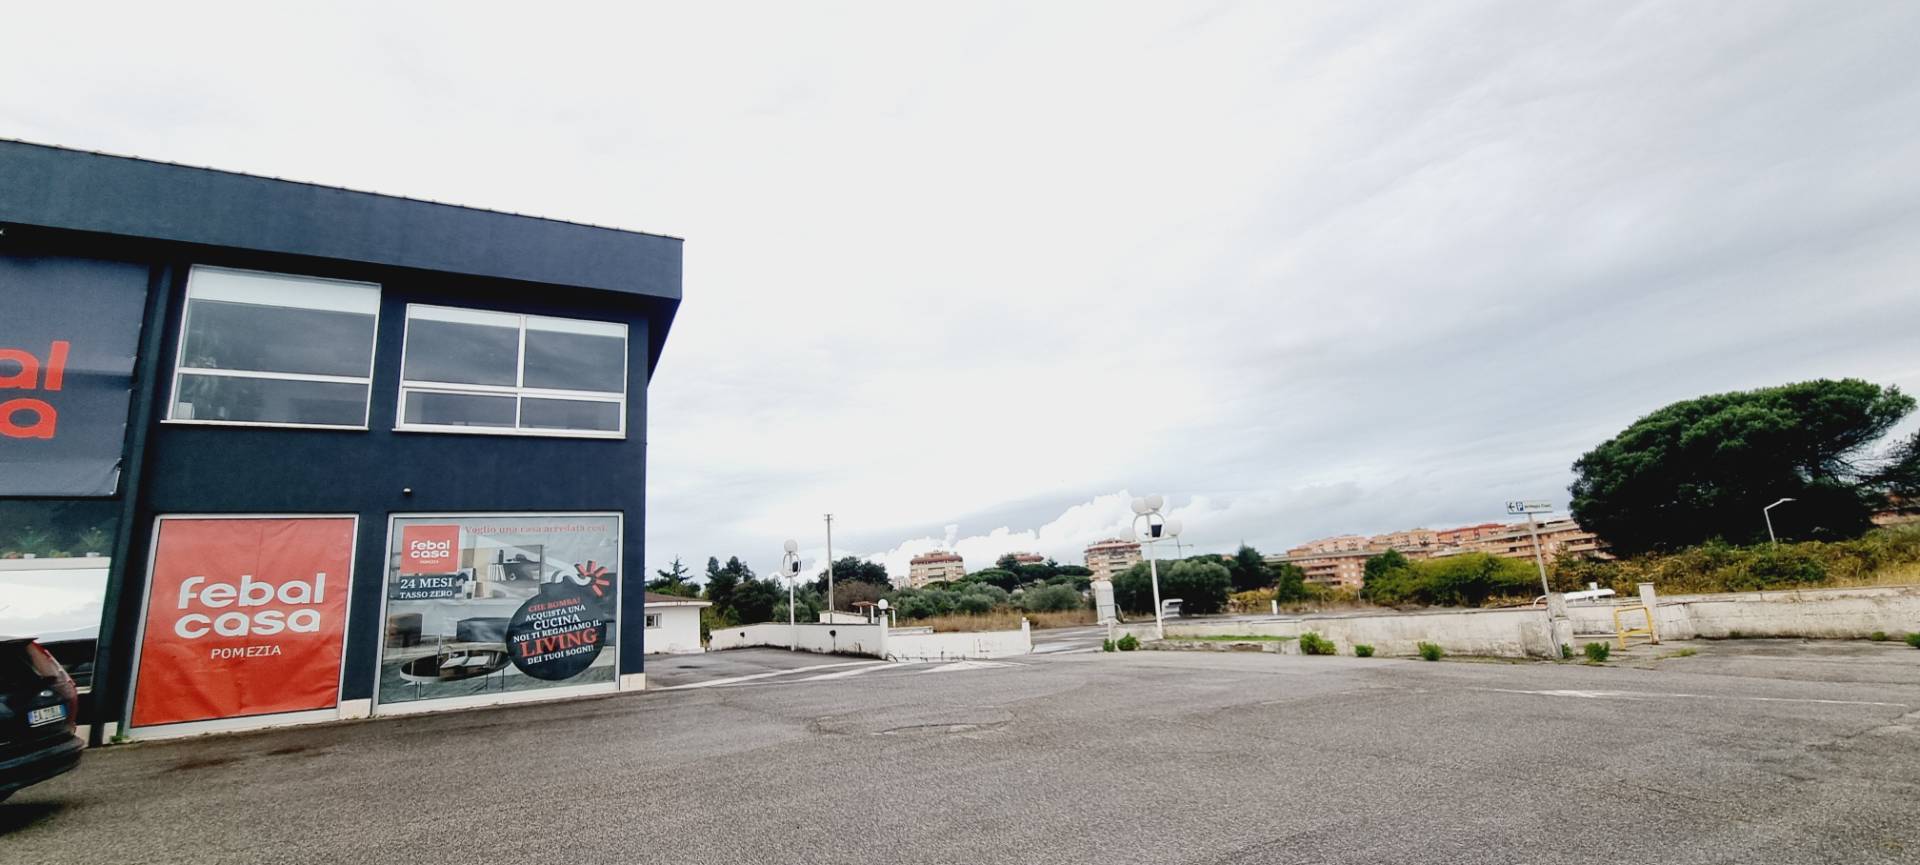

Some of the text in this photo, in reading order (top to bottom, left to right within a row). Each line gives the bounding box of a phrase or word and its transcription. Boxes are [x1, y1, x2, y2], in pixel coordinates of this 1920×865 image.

[411, 540, 450, 550] febal
[411, 550, 449, 558] casa
[400, 577, 453, 589] 24 MESI
[177, 572, 326, 609] febal
[400, 590, 453, 599] TASSO ZERO
[525, 604, 586, 622] ACQUISTA UNA
[528, 604, 547, 613] CHE
[175, 608, 321, 639] casa
[533, 613, 581, 630] CUCINA
[513, 634, 530, 643] NOI
[542, 621, 591, 637] REGALIAMO
[593, 619, 602, 627] IL
[520, 628, 597, 657] LIVING
[211, 645, 282, 659] POMEZIA
[527, 656, 542, 665] DEI
[544, 652, 564, 661] TUOI
